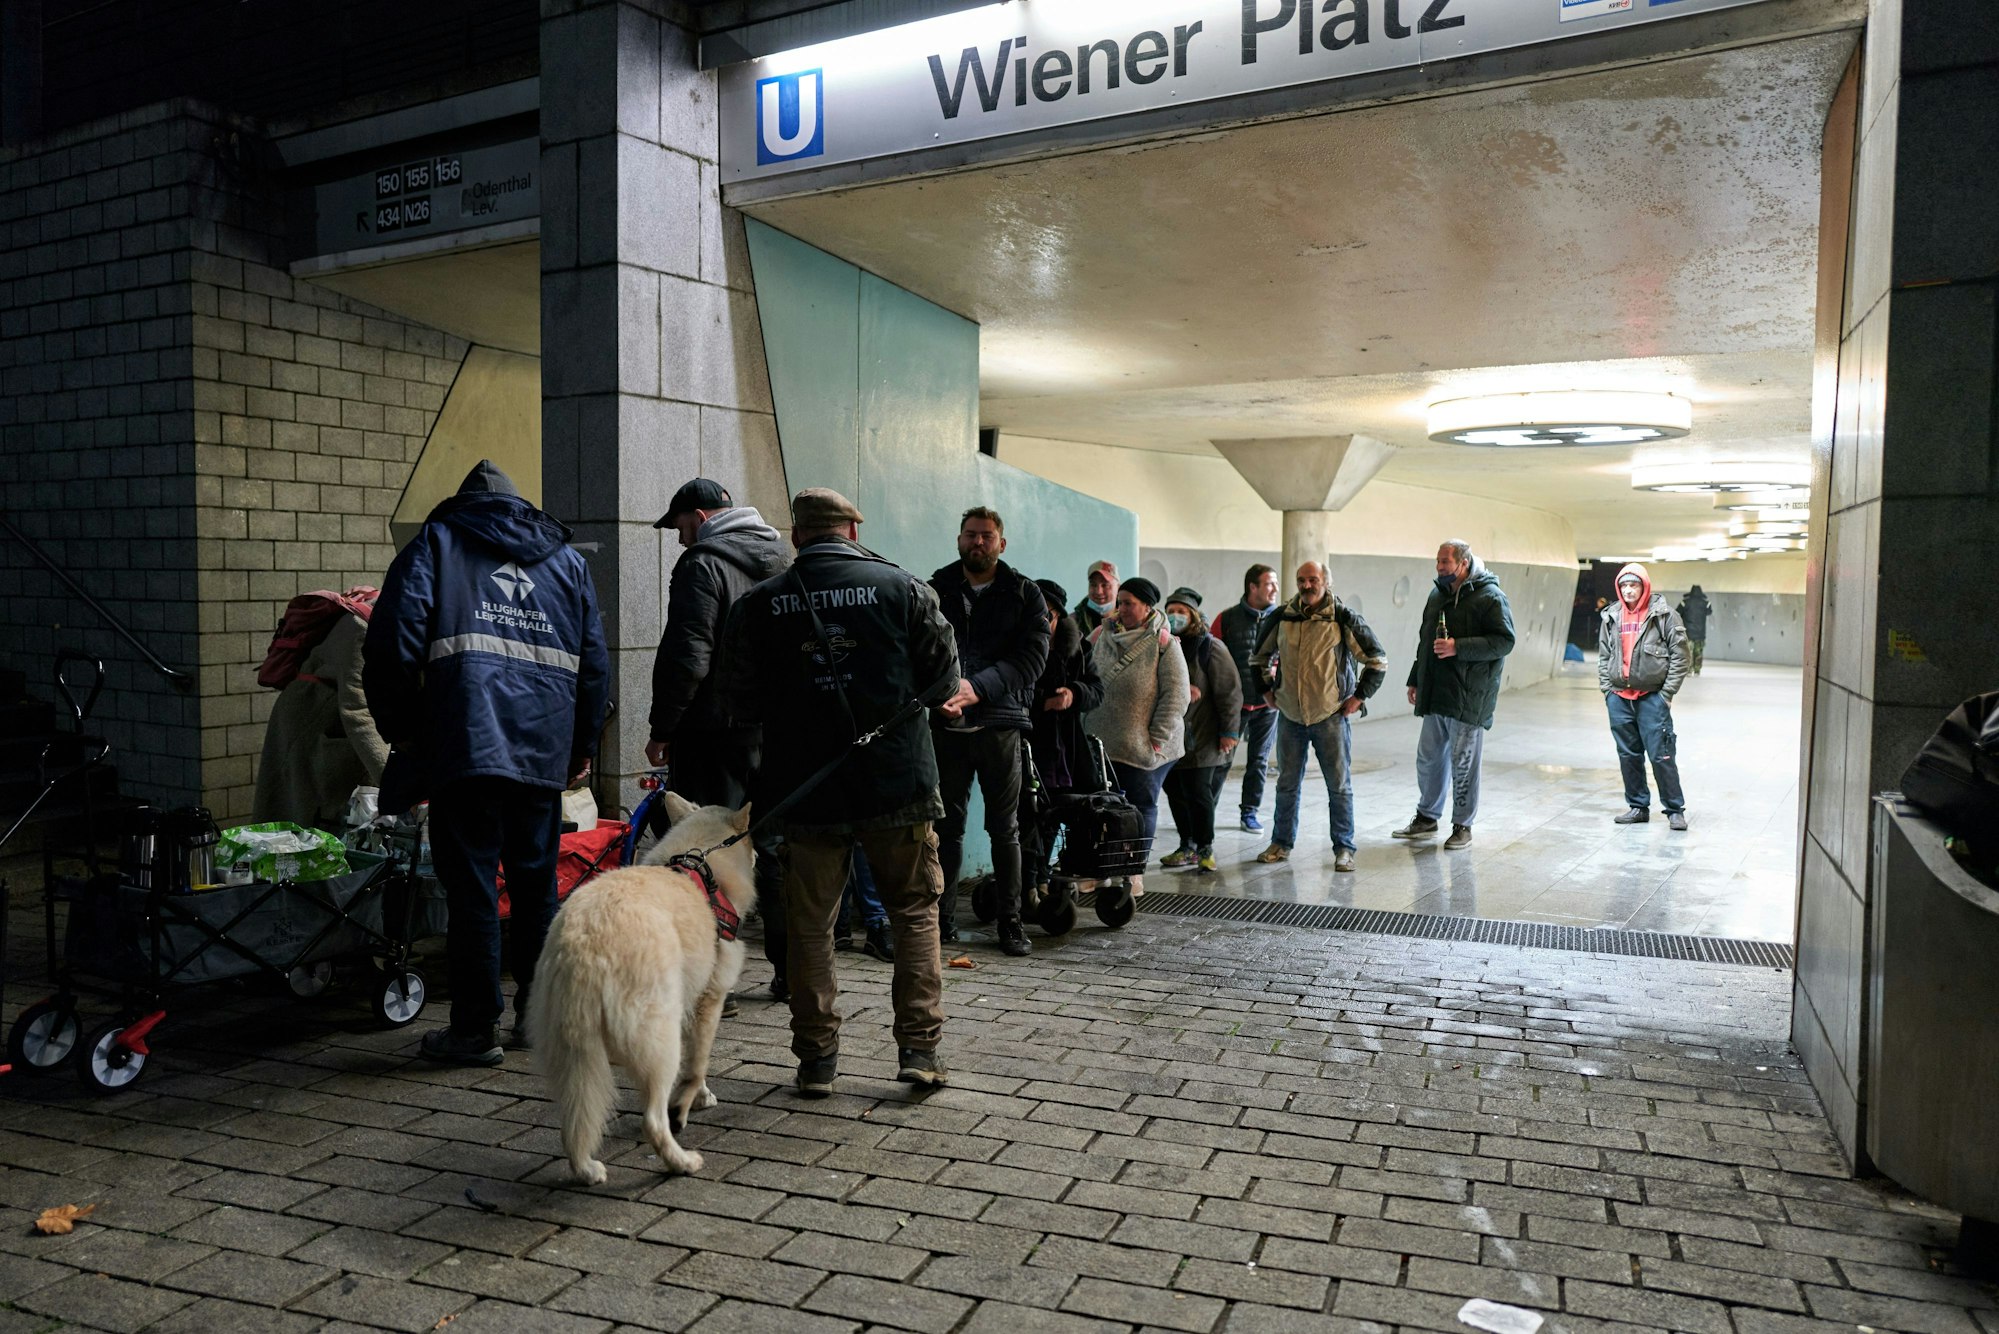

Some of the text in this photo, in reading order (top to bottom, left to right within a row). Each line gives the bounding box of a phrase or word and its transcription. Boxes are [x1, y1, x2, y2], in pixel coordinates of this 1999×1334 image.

[926, 0, 1466, 119] Wiener Platz
[761, 72, 818, 157] U
[376, 159, 461, 195] 150 155 156
[473, 172, 532, 199] Odenthal
[377, 200, 430, 228] 434 N26
[472, 199, 498, 216] Lev.
[475, 610, 553, 634] LEIPZIG-HALLE
[482, 601, 547, 622] FLUGHAFEN
